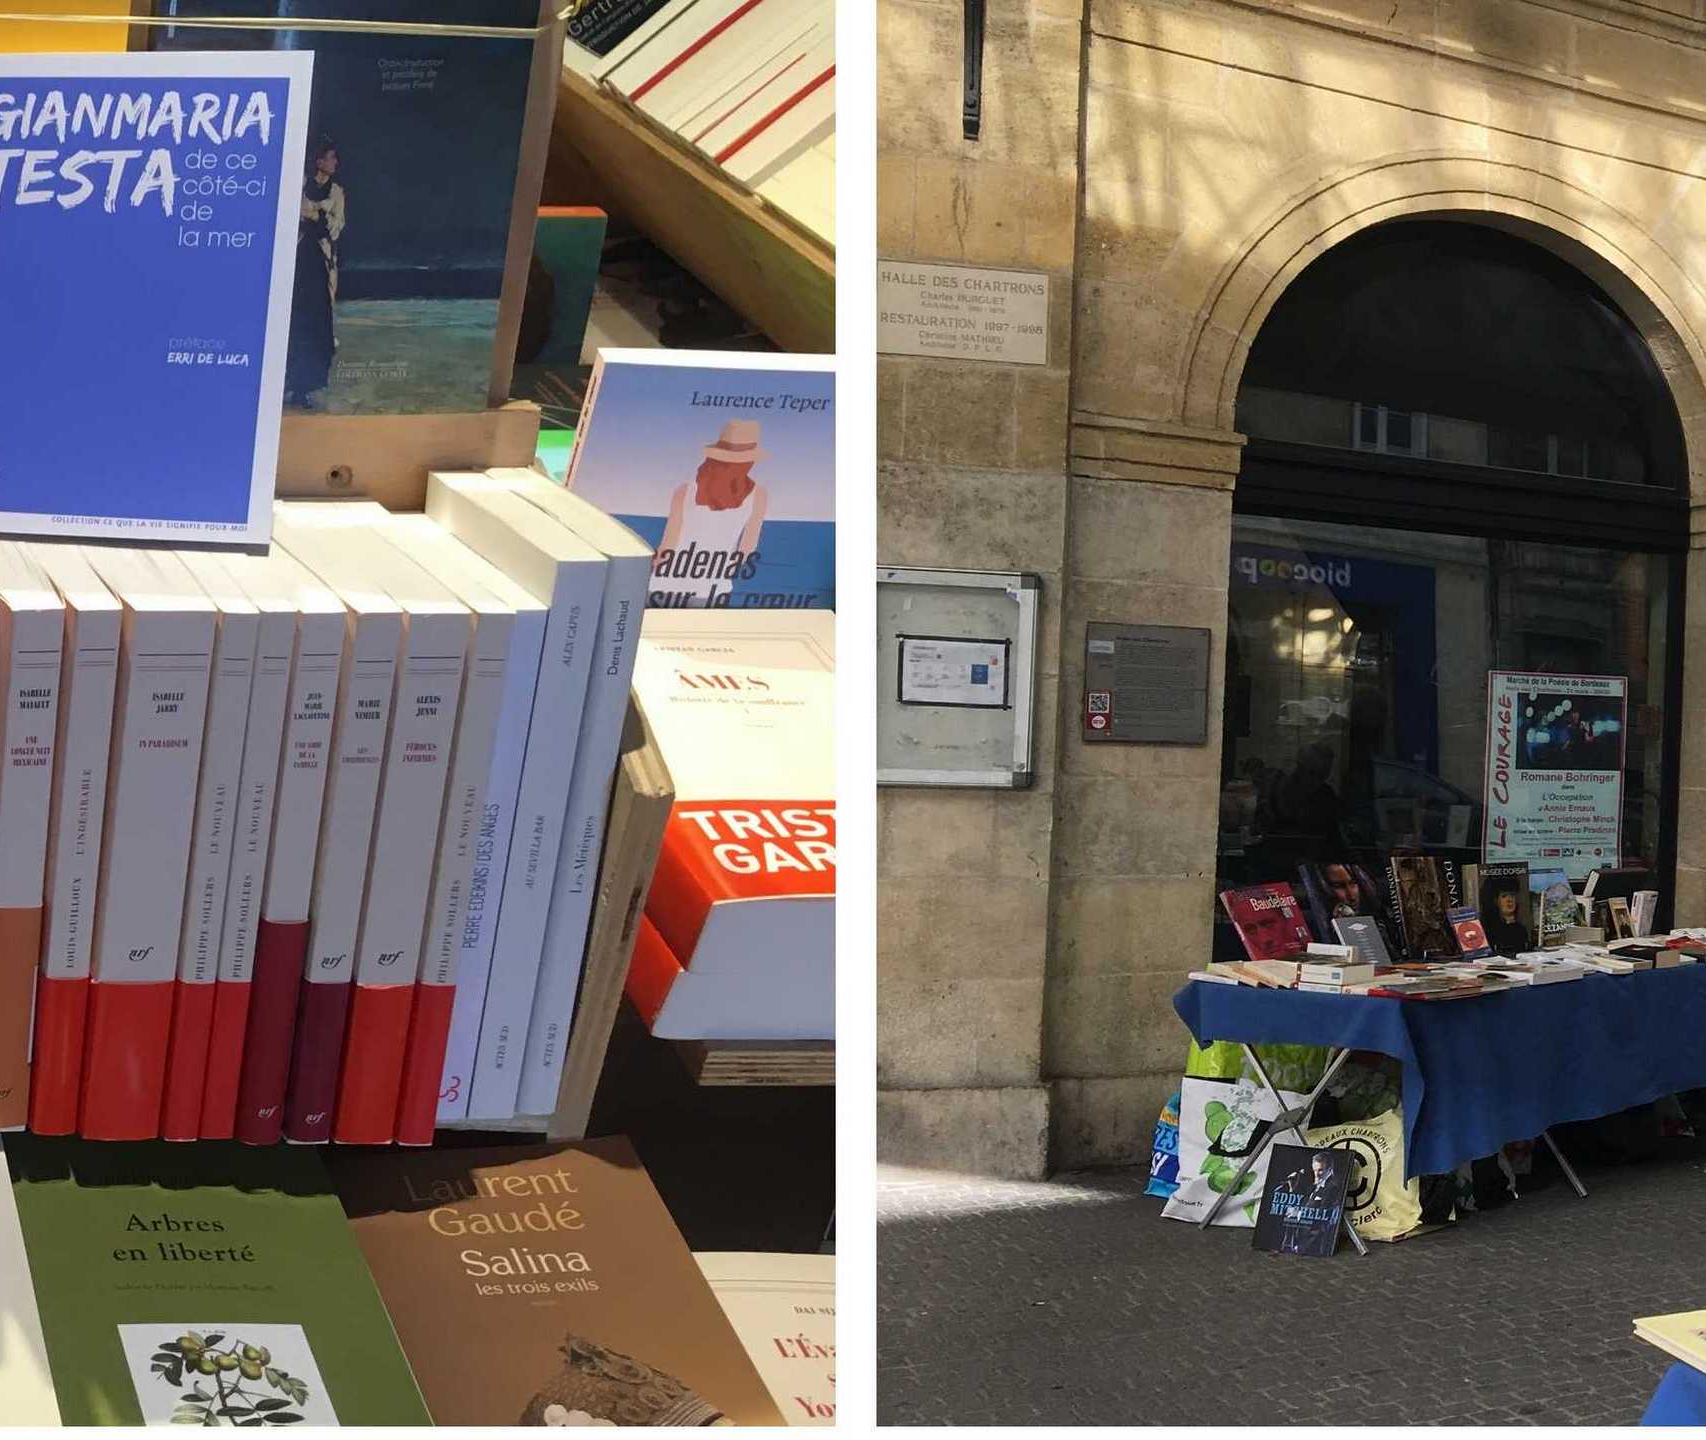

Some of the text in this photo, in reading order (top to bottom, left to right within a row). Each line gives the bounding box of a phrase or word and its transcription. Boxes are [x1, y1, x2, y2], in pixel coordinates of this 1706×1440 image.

[185, 149, 257, 170] de ce
[183, 175, 266, 196] côté-ci
[180, 201, 213, 221] de
[207, 231, 256, 248] mer
[881, 271, 1045, 295] HALLE DES CHARTRONS
[880, 312, 976, 330] RESTAURATION
[167, 352, 213, 365] ERRI DE
[691, 391, 830, 412] Laurence Teper
[1490, 694, 1512, 849] LE COURAGE
[1521, 772, 1615, 784] Romane Bohringer
[713, 840, 836, 874] GAR
[1249, 893, 1297, 912] Baudelaire
[1272, 1192, 1304, 1205] EDDY
[124, 1211, 227, 1235] Arbres
[427, 1201, 586, 1237] Gaudé
[112, 1243, 257, 1265] en liberté
[460, 1248, 591, 1278] Salina
[475, 1277, 599, 1296] les trois exils
